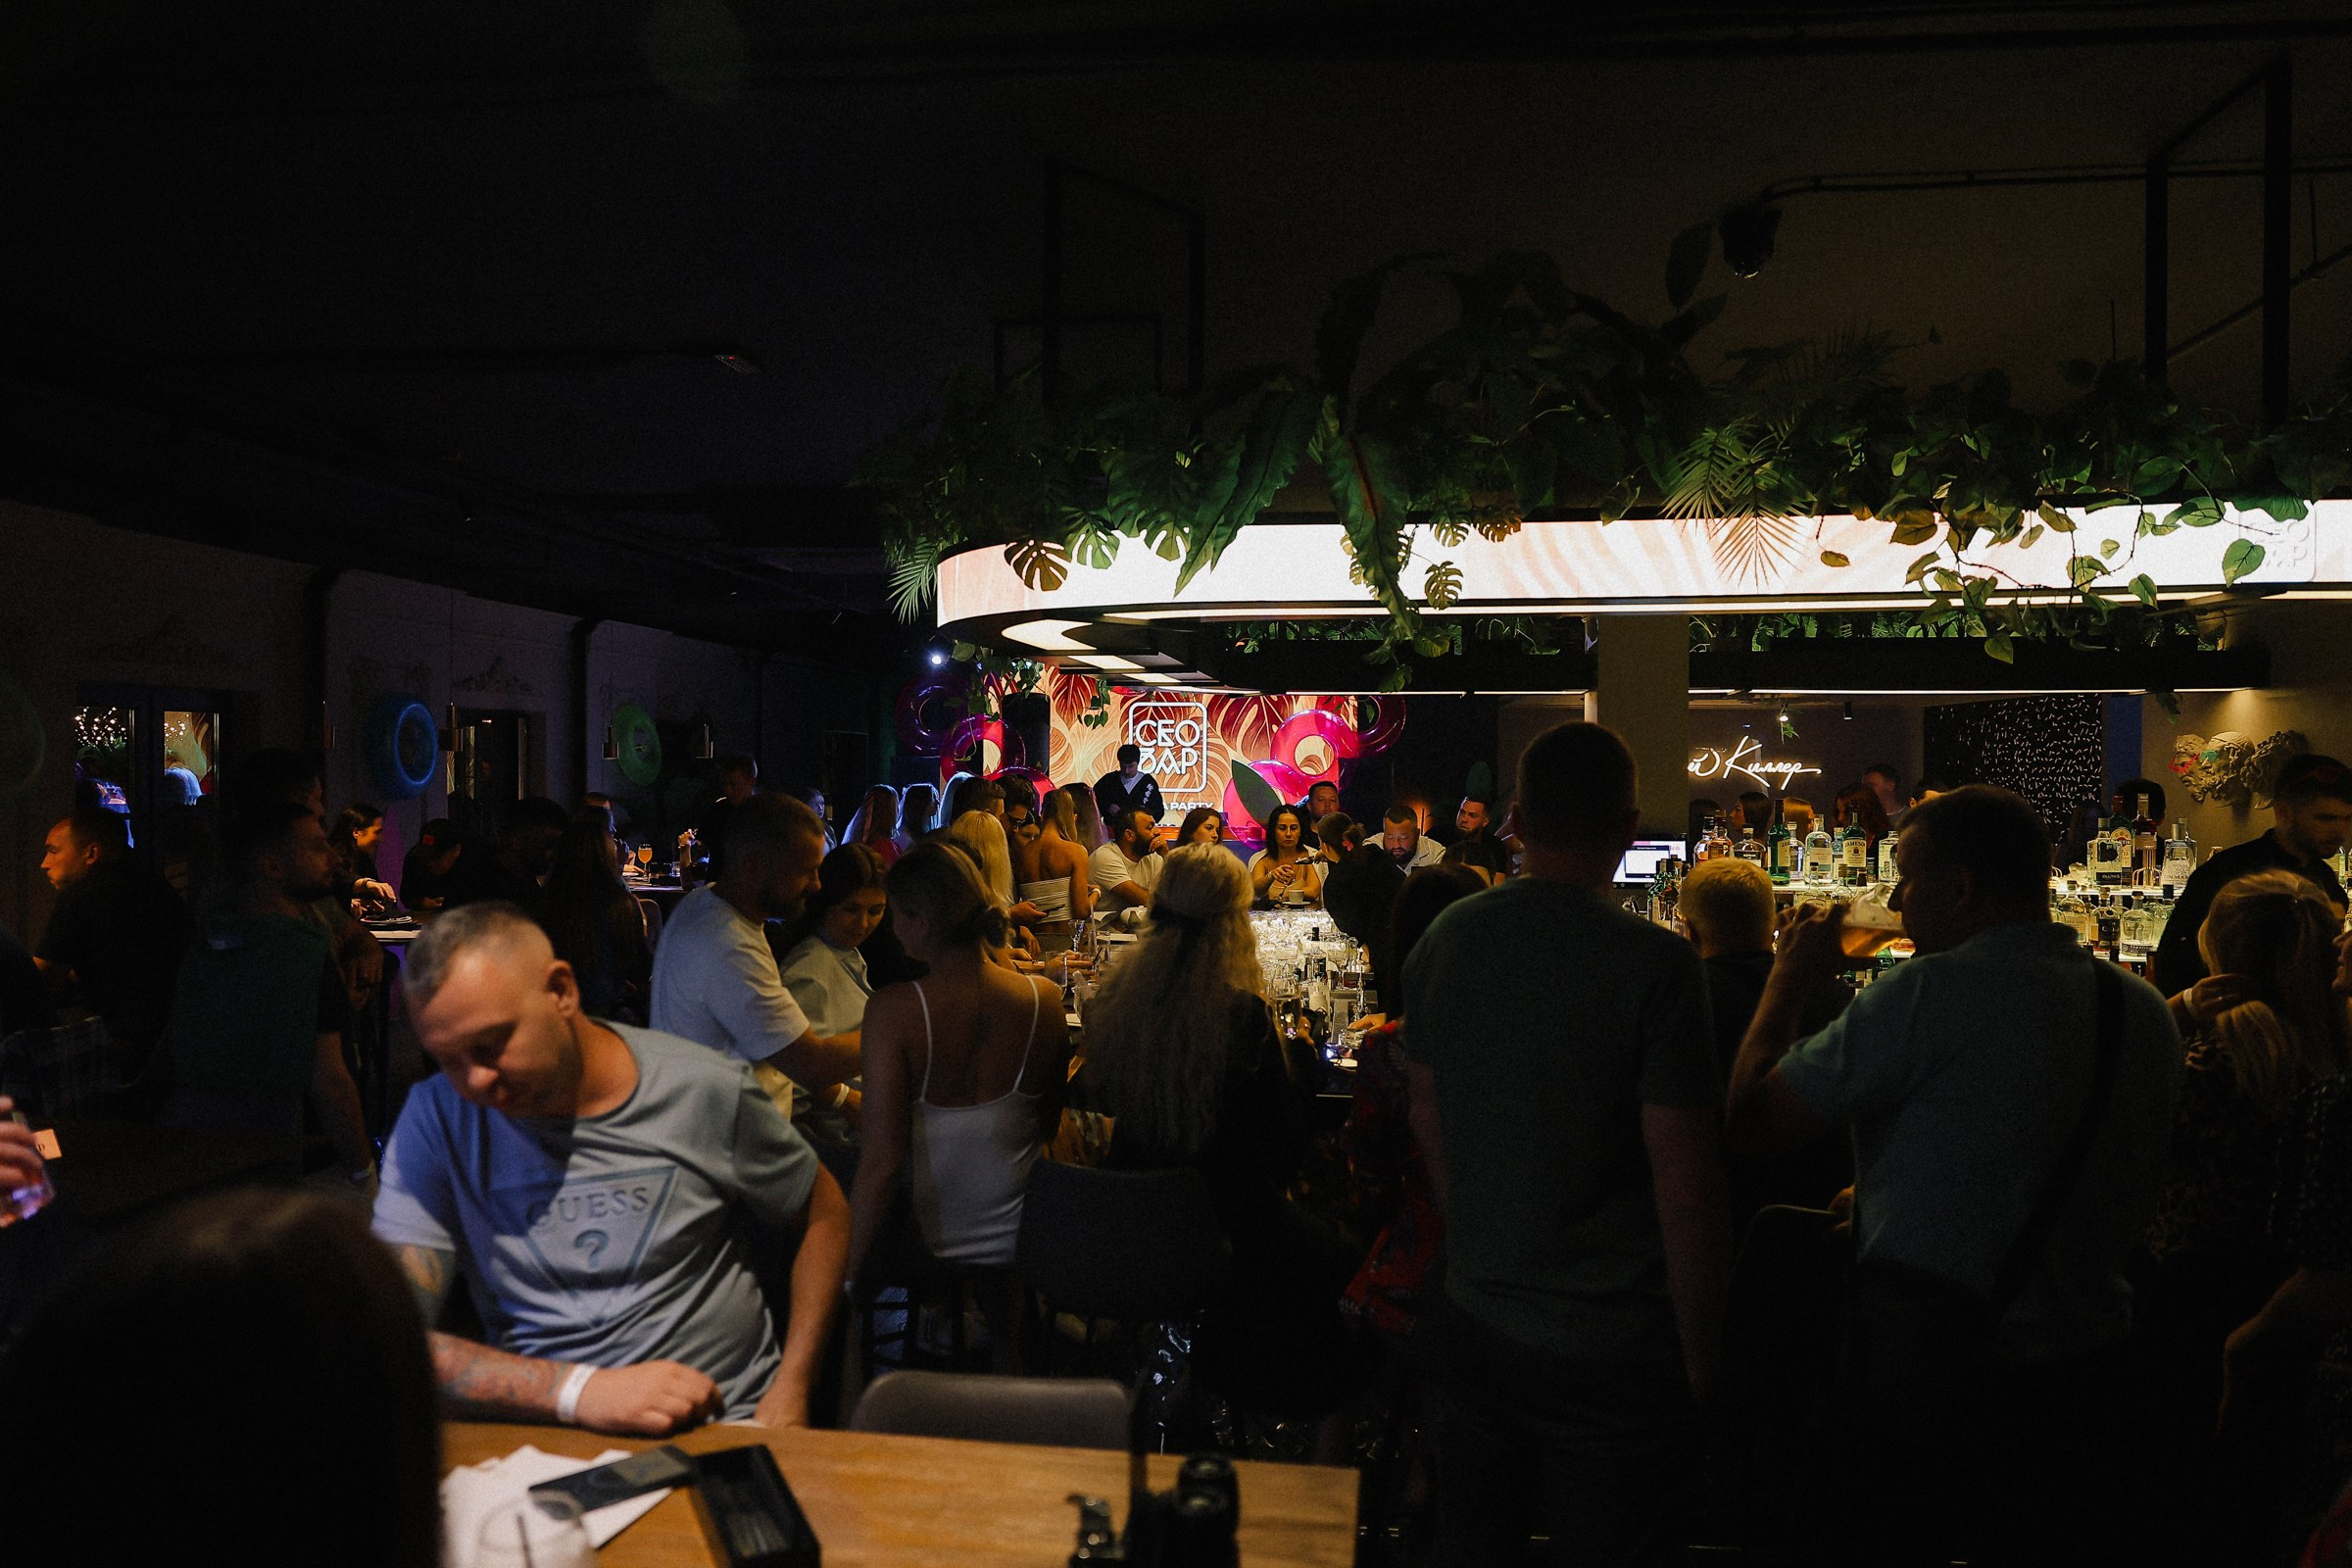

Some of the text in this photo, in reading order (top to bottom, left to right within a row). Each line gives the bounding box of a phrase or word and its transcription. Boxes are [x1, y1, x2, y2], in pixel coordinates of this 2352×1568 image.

[1723, 735, 1823, 791] Киллер
[1170, 802, 1214, 810] PARTY
[525, 1187, 649, 1227] GUESS
